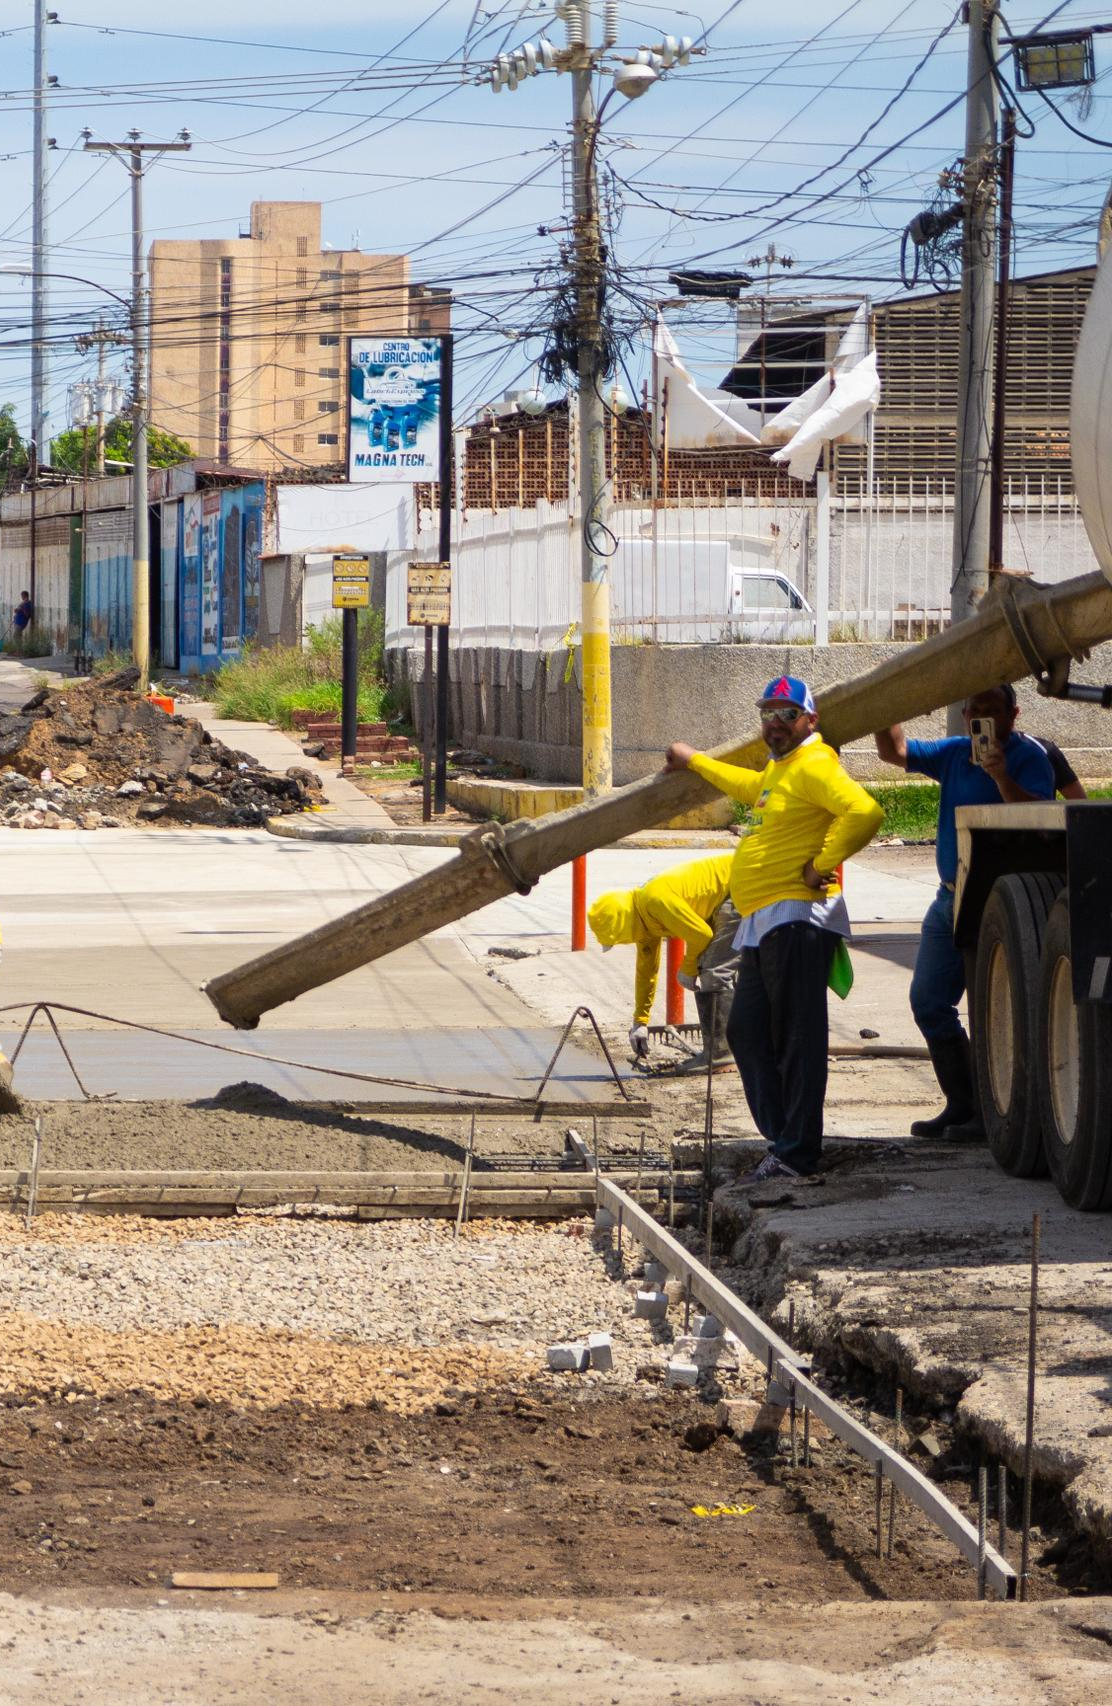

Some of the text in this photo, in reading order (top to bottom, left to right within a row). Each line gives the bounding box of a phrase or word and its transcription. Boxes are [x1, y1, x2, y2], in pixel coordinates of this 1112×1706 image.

[383, 343, 409, 351] CENTRO
[359, 352, 369, 363] DE
[355, 453, 396, 466] MAGNA
[400, 454, 425, 466] TECH
